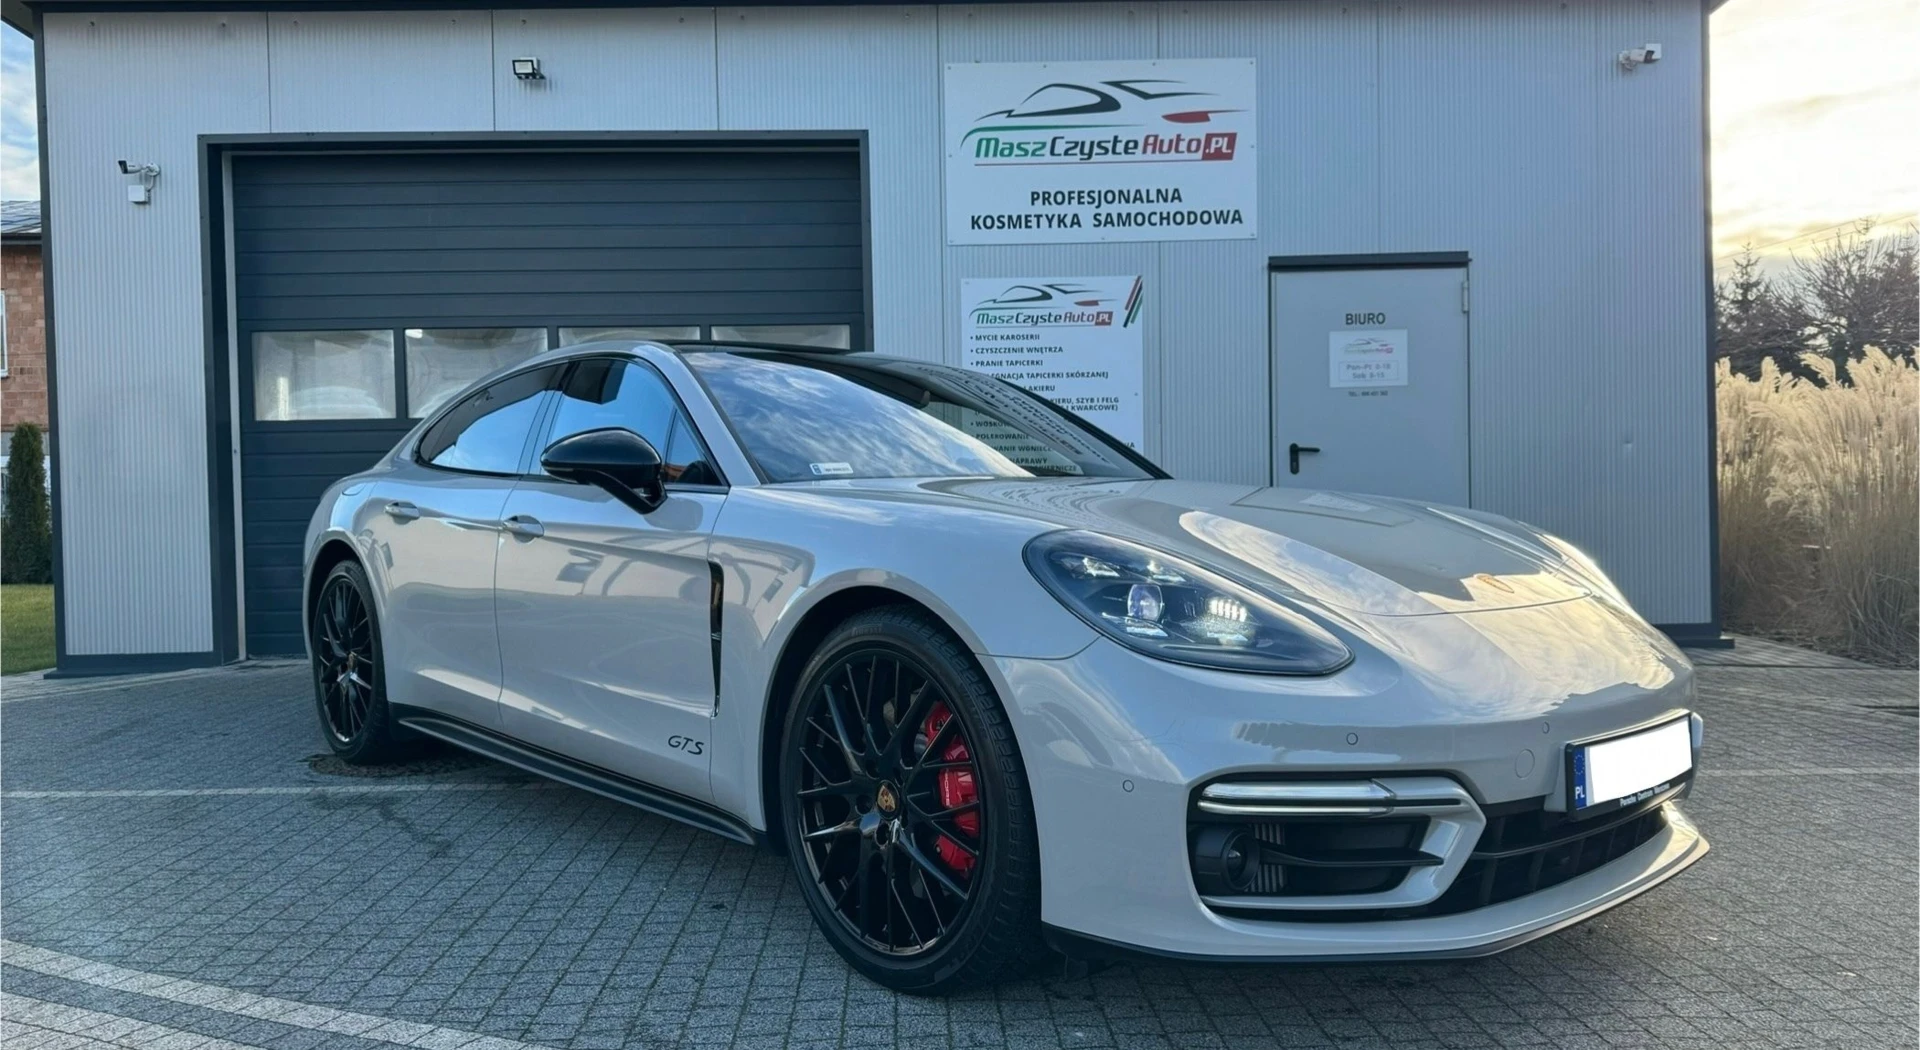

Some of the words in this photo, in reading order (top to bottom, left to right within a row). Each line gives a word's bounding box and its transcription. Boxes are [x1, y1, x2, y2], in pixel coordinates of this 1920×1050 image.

[1030, 188, 1182, 208] PROFESJONALNA
[971, 213, 1082, 230] KOSMETYKA
[1092, 209, 1243, 228] SAMOCHODOWA
[1345, 312, 1386, 325] BIURO
[1026, 346, 1063, 354] WNĘTRZA
[1005, 359, 1043, 367] TAPICERKI
[1065, 371, 1109, 379] SKÓRZANEJ
[668, 735, 705, 756] GTS
[1575, 786, 1585, 800] PL
